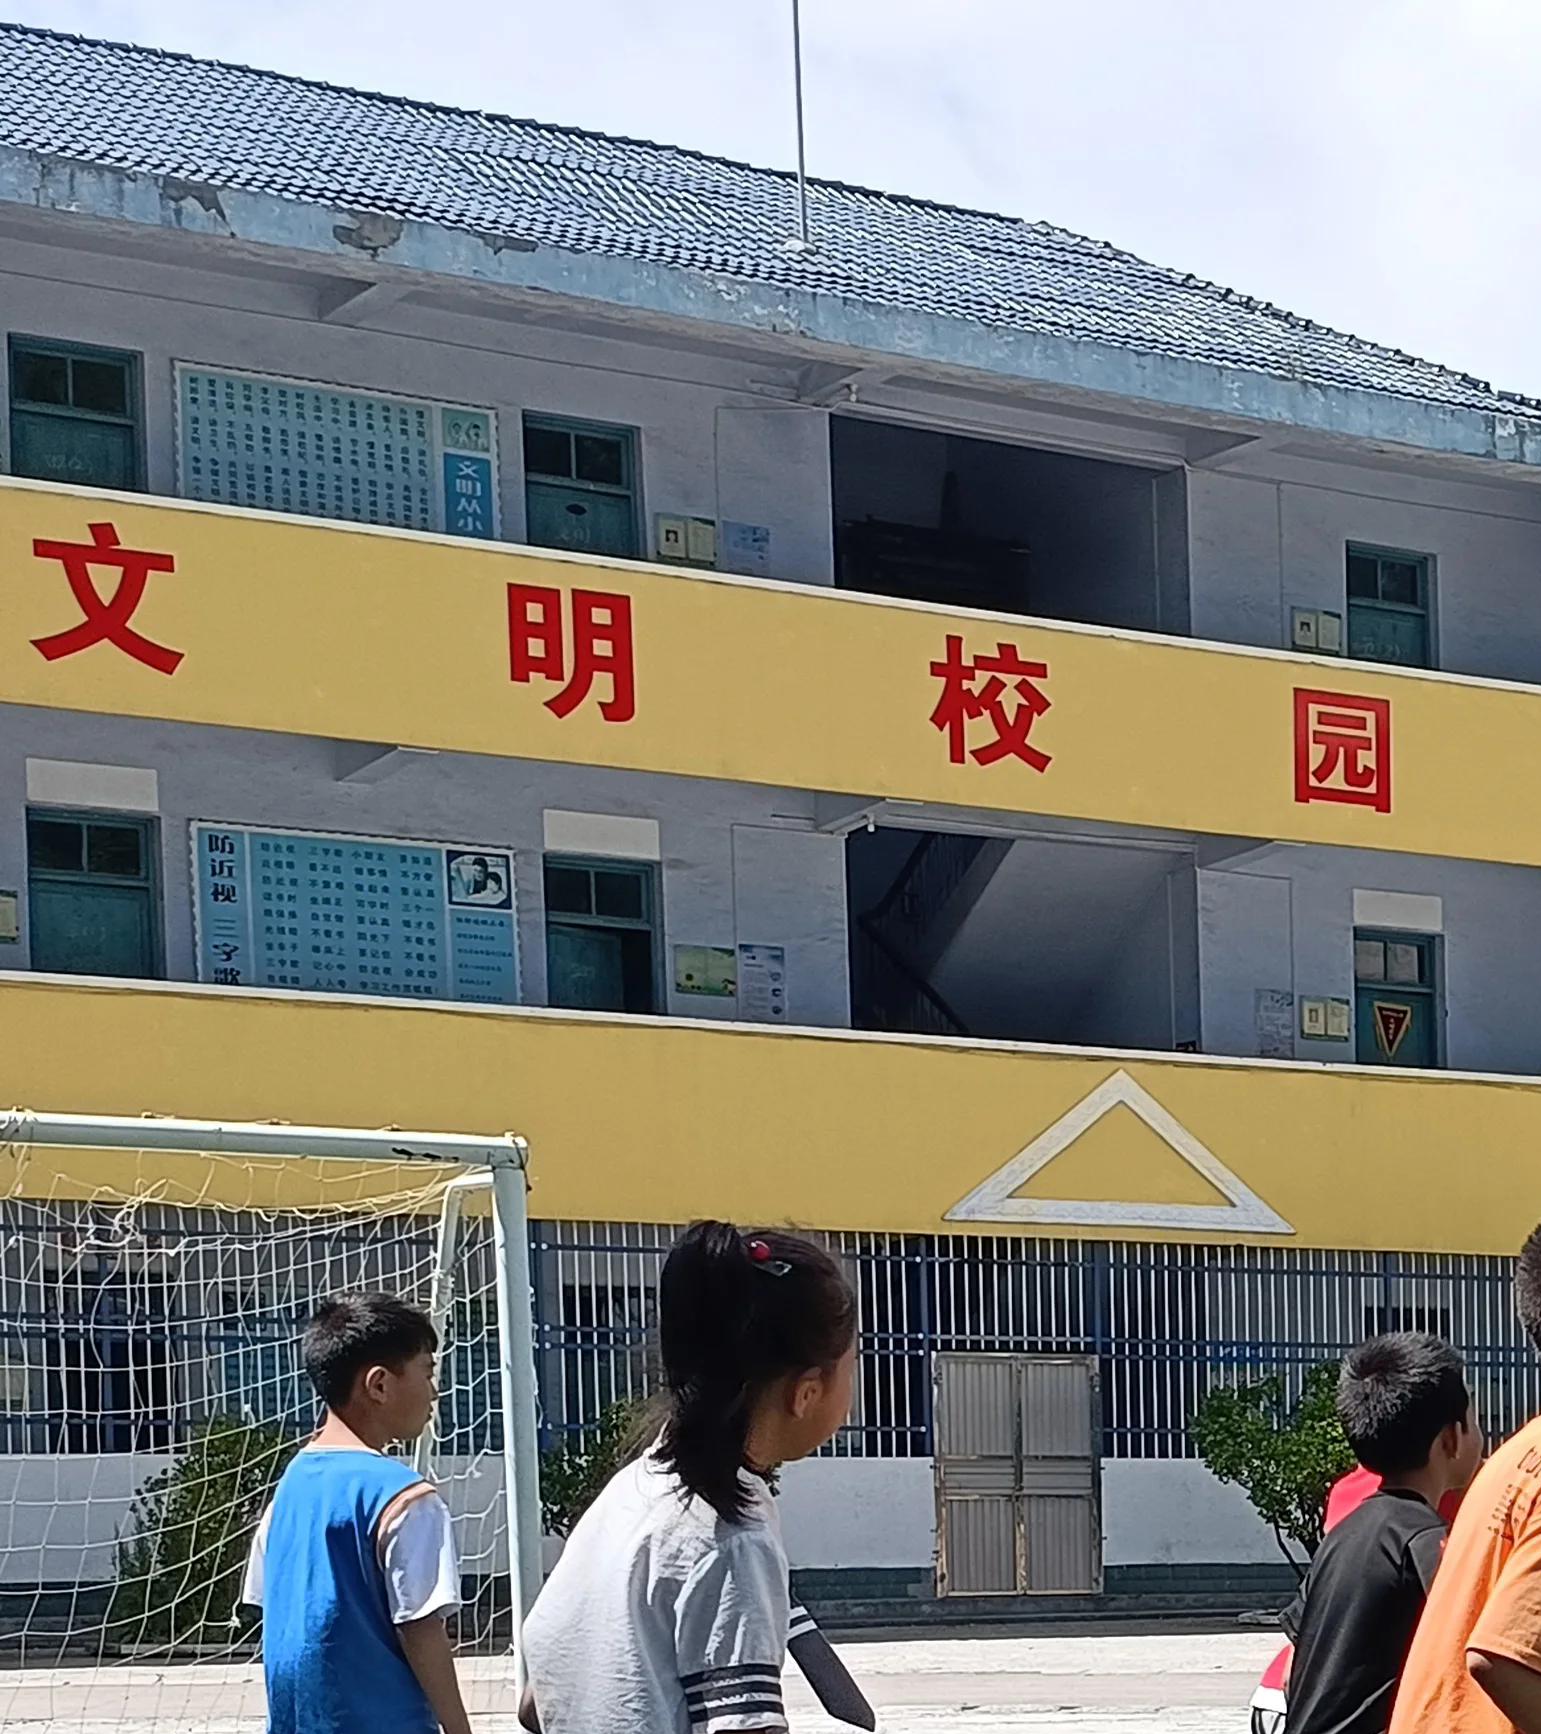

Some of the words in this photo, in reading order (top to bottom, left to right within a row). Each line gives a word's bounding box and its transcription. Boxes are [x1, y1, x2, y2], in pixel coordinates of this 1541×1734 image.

[456, 461, 482, 531] 文明从小
[208, 834, 238, 903] 防近视
[212, 918, 240, 984] 三字歌
